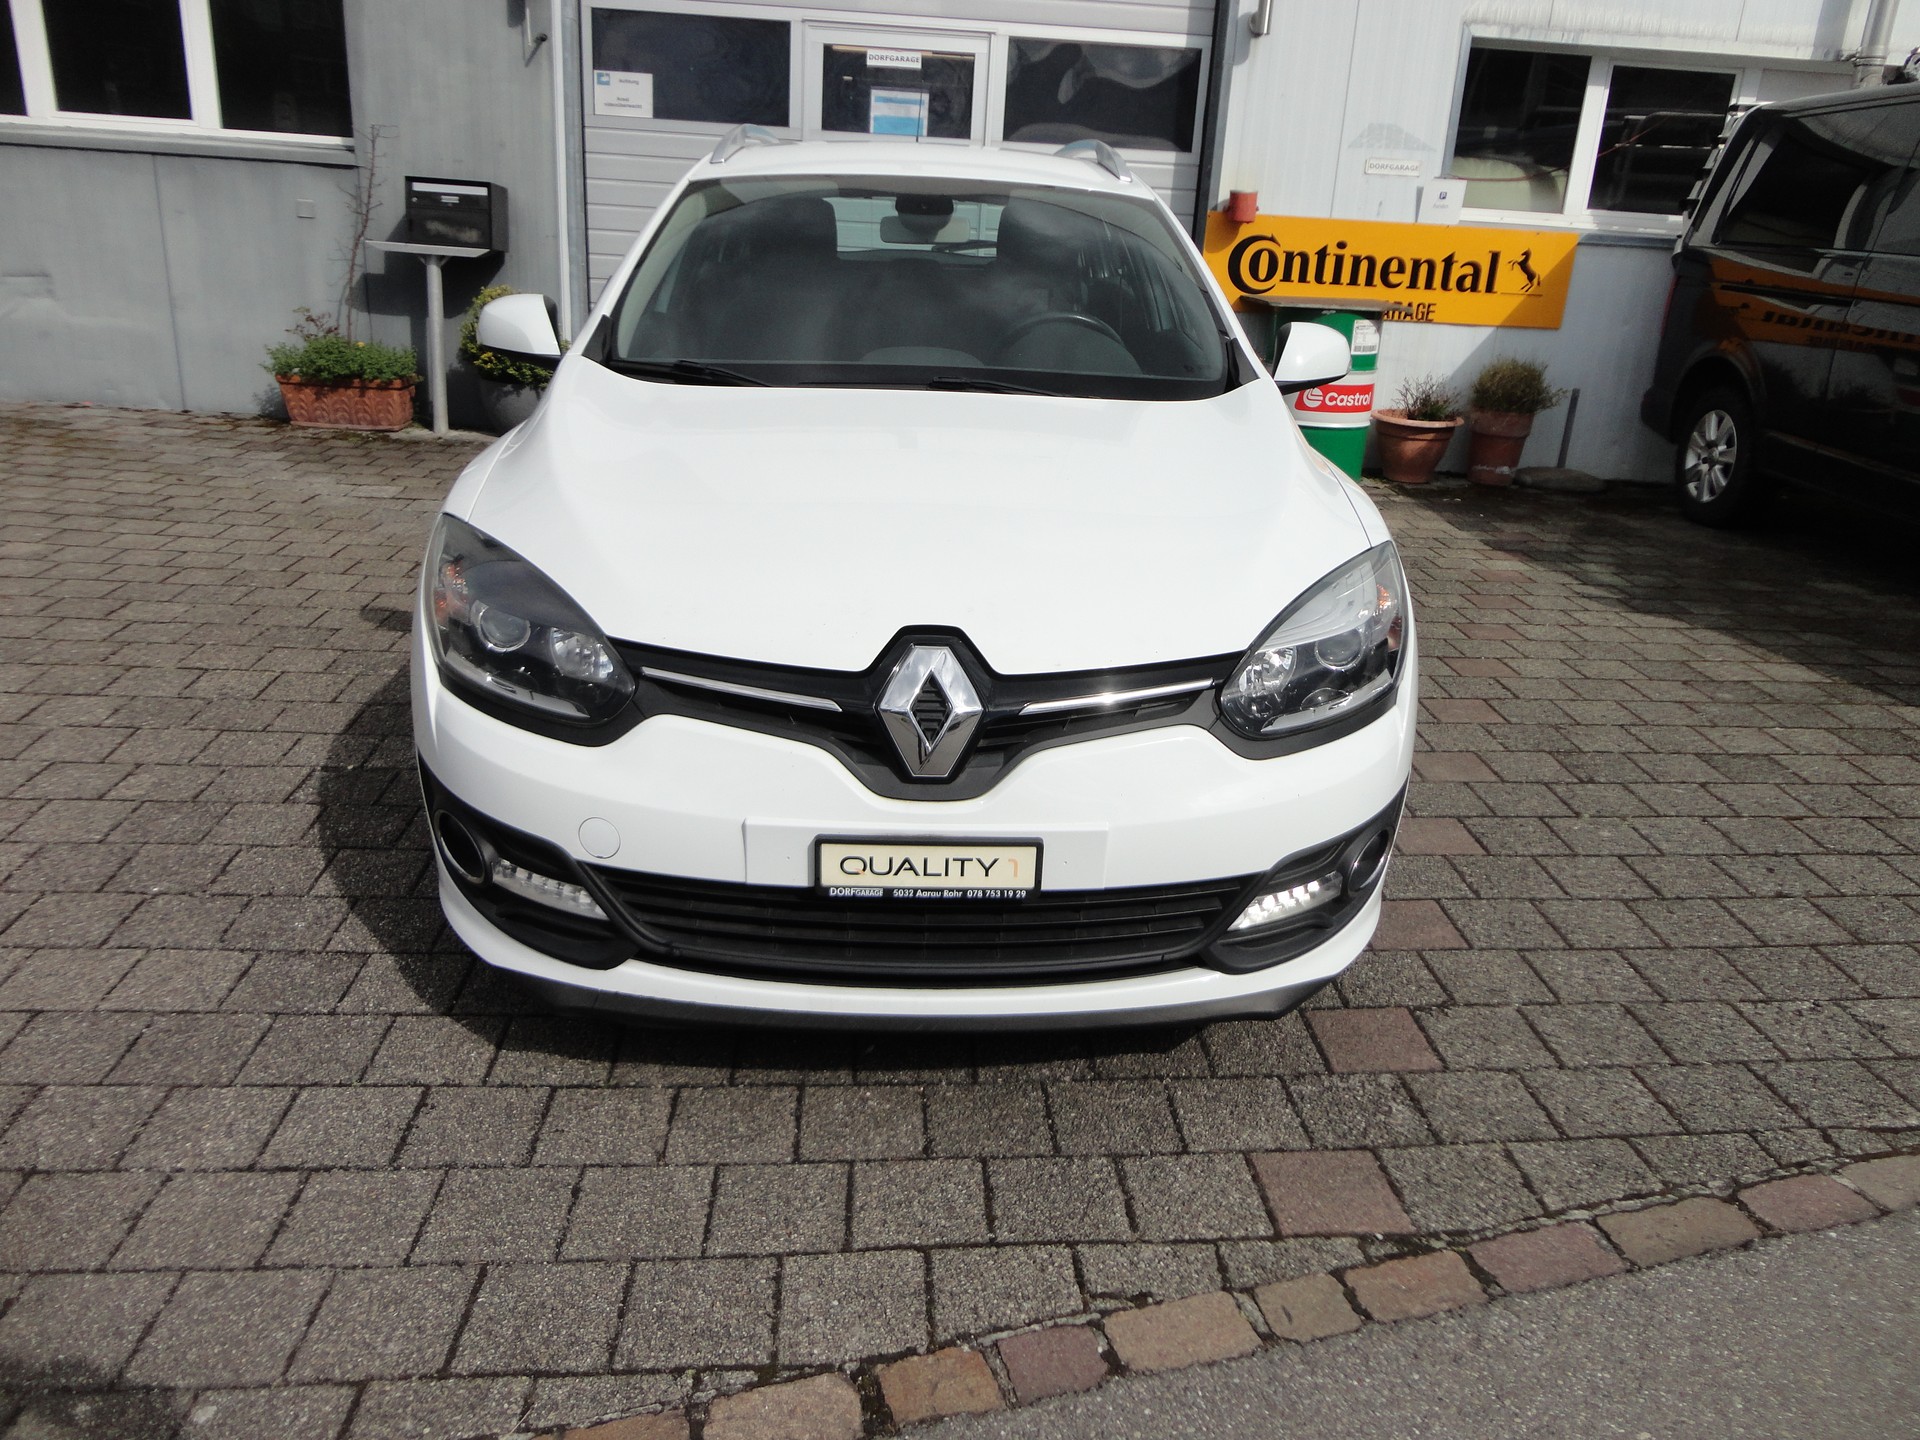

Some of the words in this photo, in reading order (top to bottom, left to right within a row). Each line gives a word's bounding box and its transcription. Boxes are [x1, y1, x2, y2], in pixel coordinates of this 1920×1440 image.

[868, 53, 920, 63] DORFGARAGE
[1369, 162, 1419, 171] DORFGARAGE
[1227, 233, 1501, 294] Continental
[1325, 391, 1372, 407] Castrol
[839, 855, 1000, 877] QUALITY
[893, 888, 914, 897] 5032
[916, 888, 941, 898] Aarau
[943, 889, 963, 898] Rohr
[967, 889, 983, 898] 078
[985, 889, 1001, 898] 753
[1003, 890, 1013, 898] 19
[1015, 890, 1027, 898] 29
